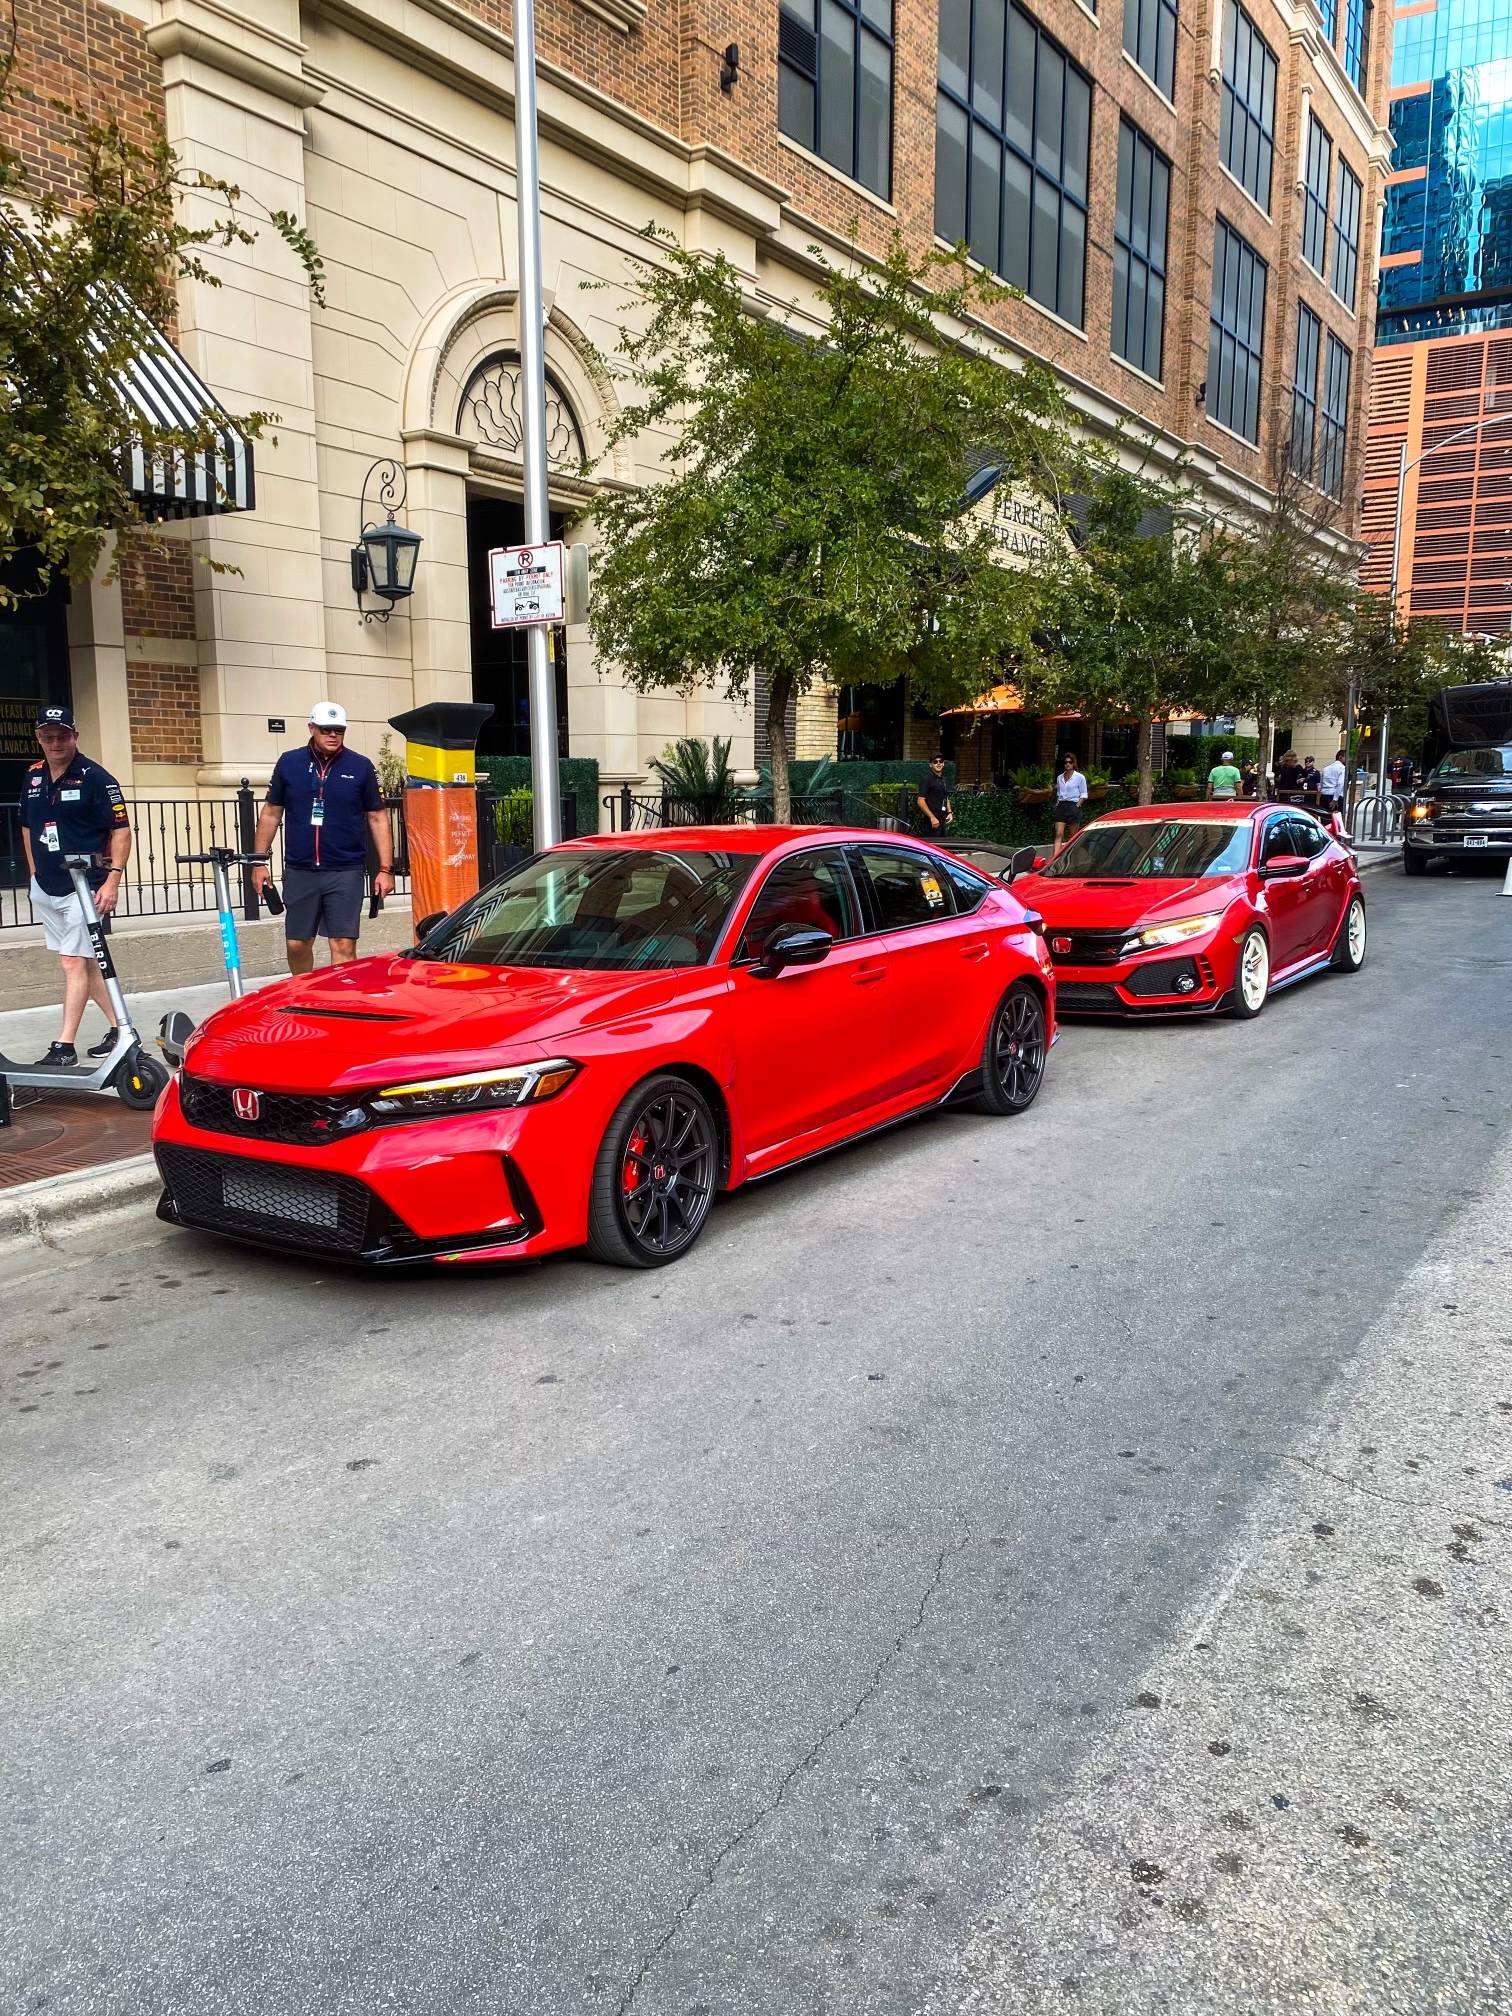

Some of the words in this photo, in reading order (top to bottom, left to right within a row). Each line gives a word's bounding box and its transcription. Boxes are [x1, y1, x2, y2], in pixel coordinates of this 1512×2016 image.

[0, 704, 24, 719] LEASE
[0, 721, 33, 737] NTRANCE
[90, 932, 108, 970] BIRD
